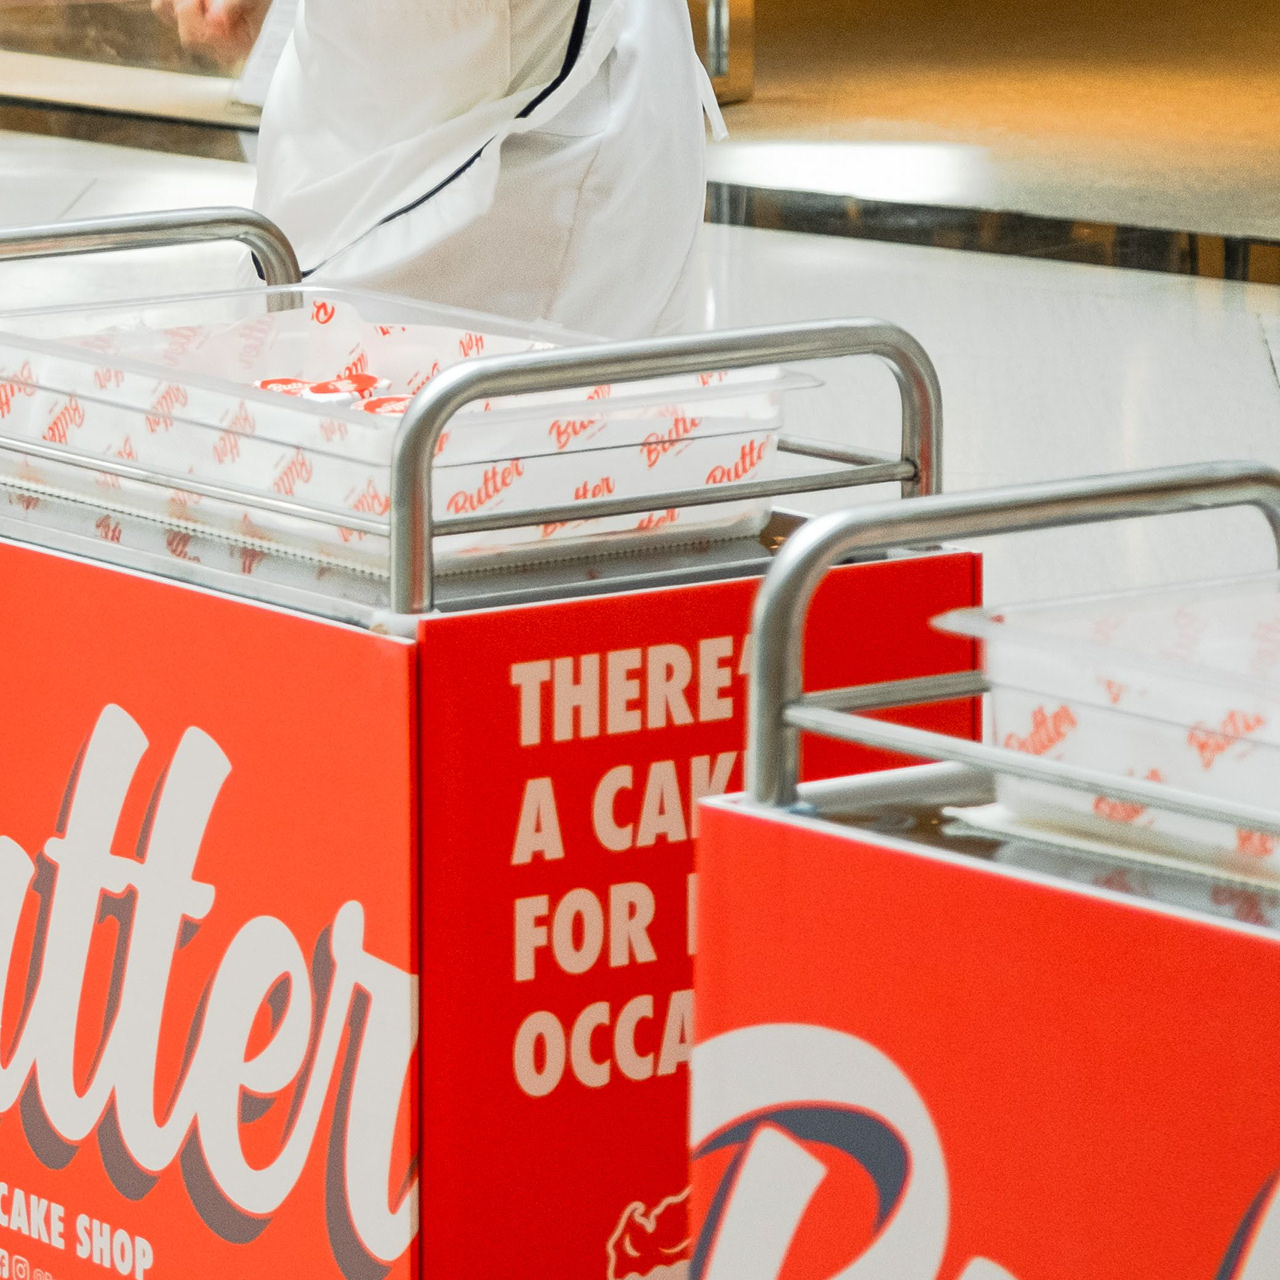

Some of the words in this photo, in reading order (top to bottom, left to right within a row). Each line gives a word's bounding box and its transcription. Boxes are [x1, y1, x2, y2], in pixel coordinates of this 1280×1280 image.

[510, 776, 566, 866] A
[591, 751, 746, 852] CAK
[511, 880, 657, 983] FOR
[513, 988, 694, 1098] OCCA
[75, 1213, 154, 1280] SHOP
